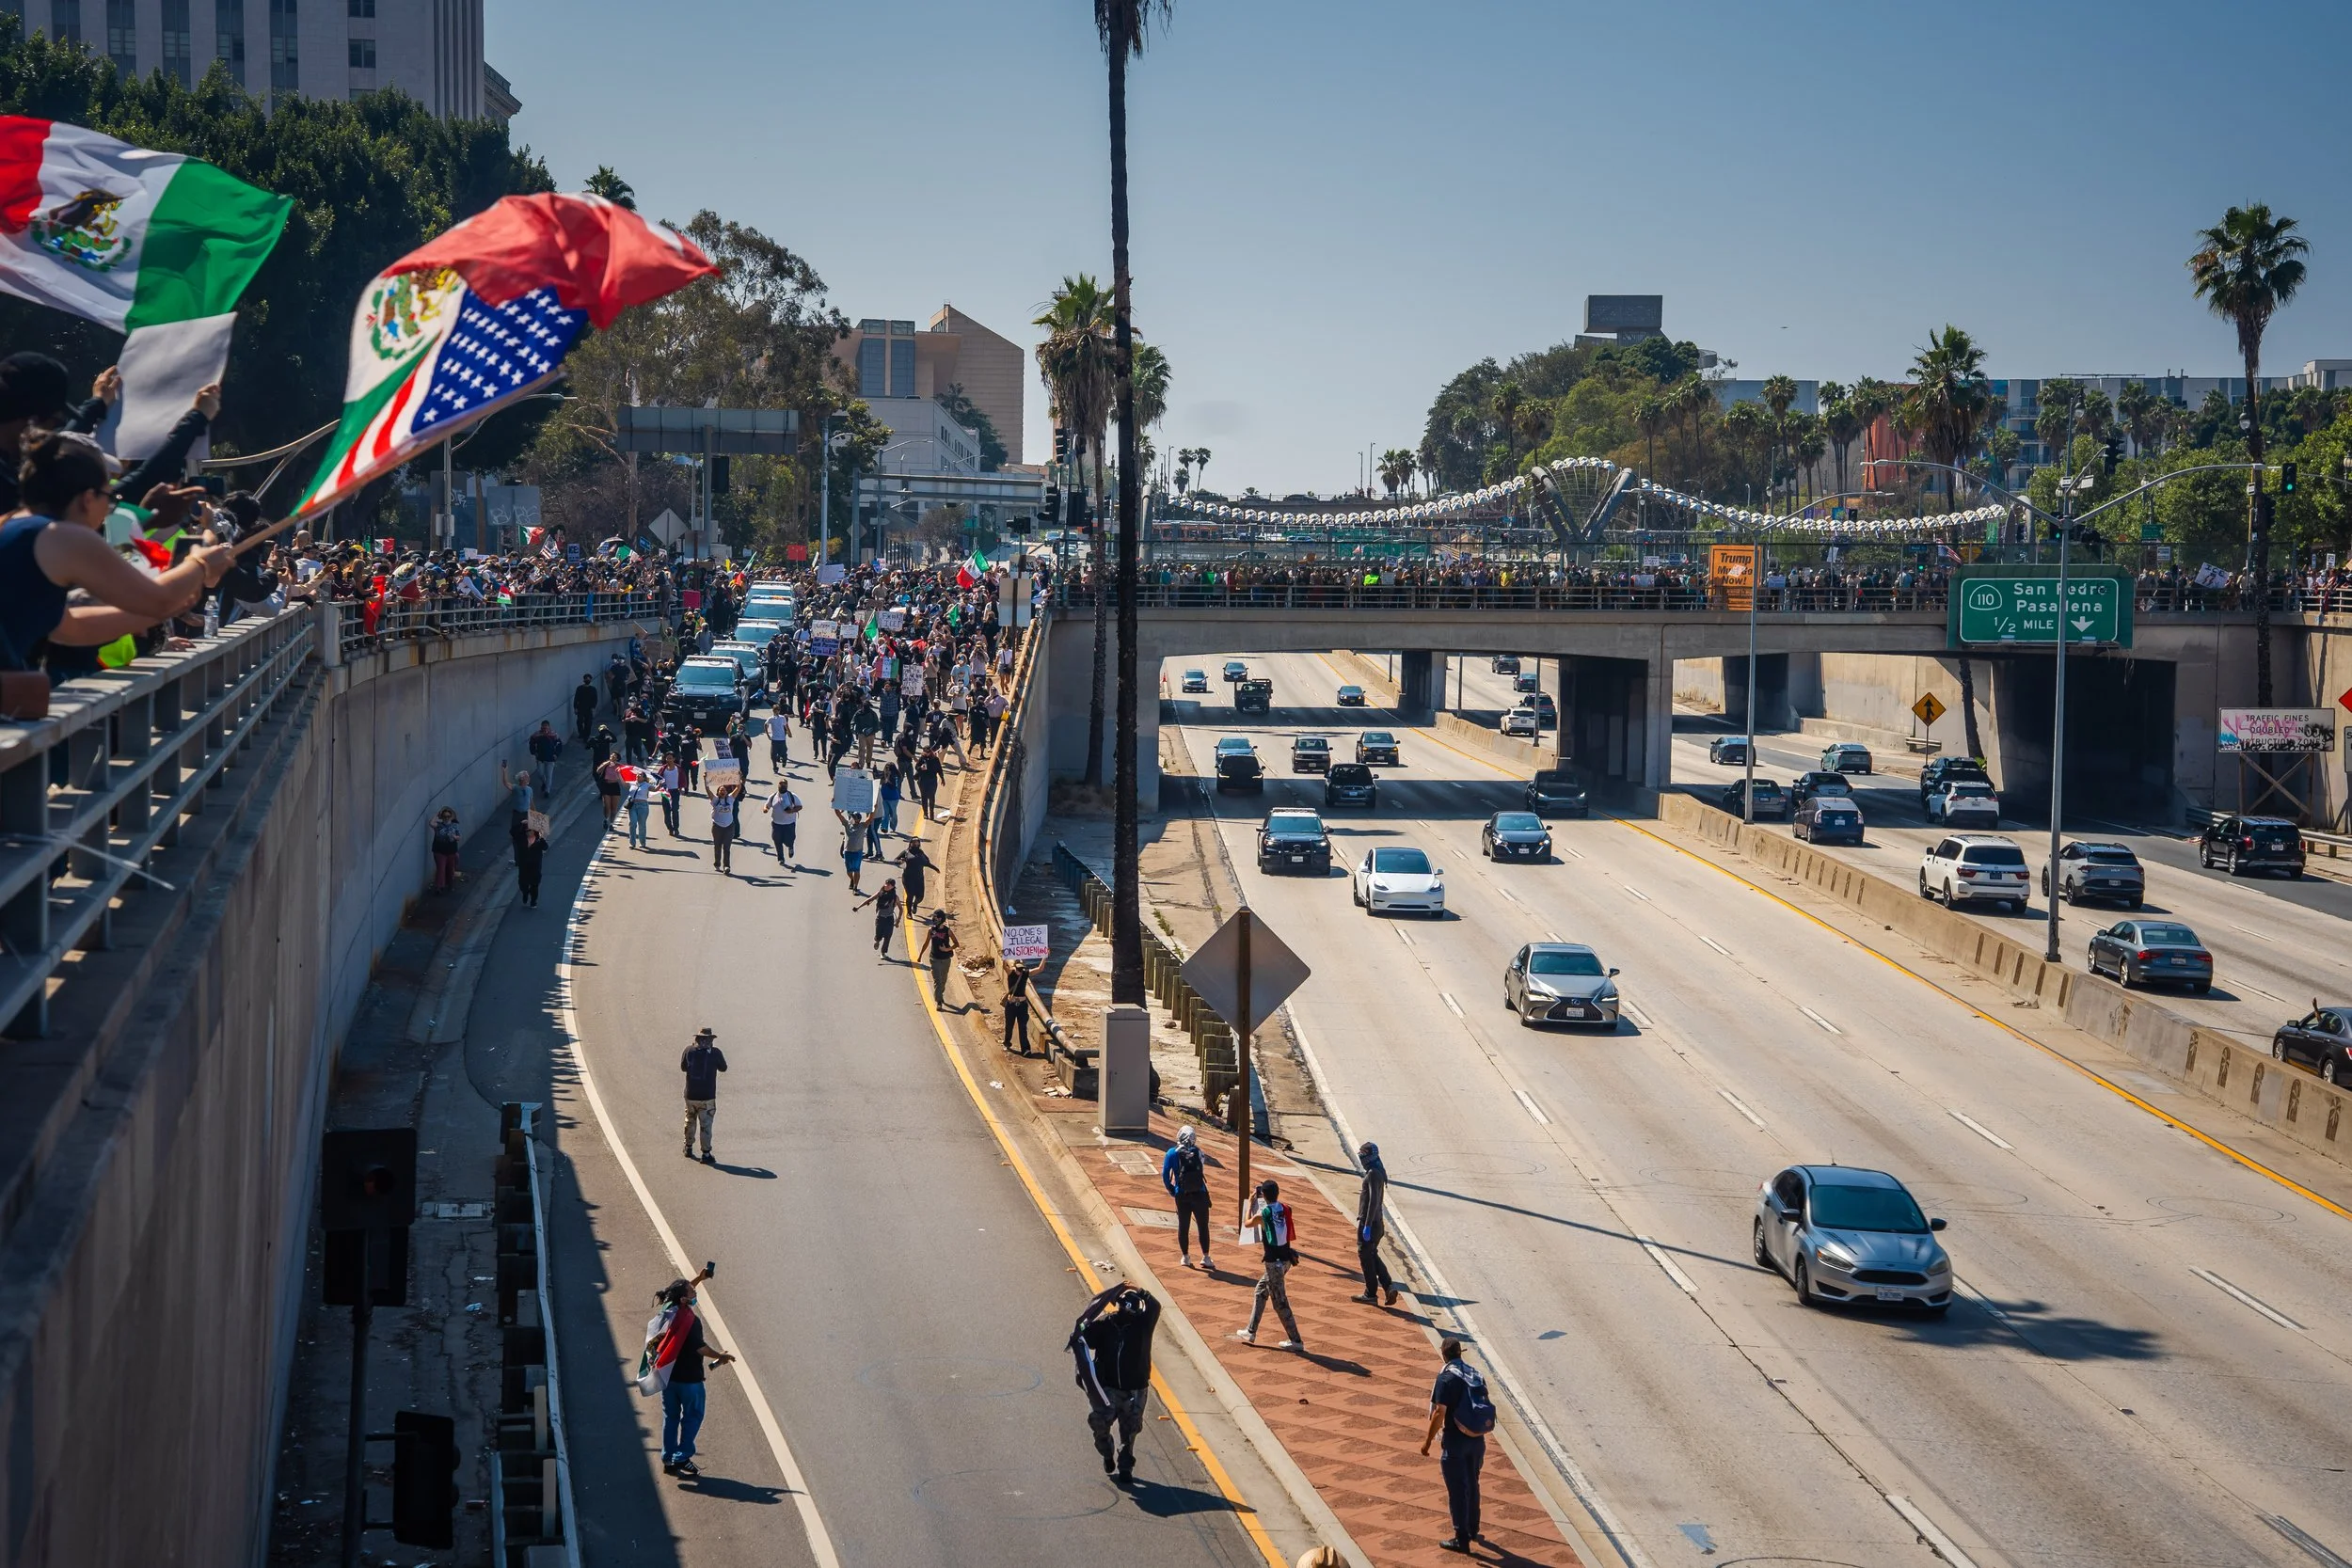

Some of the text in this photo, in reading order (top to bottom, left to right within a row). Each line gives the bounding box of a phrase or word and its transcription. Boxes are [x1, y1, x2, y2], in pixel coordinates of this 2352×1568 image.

[1720, 553, 1752, 565] Trump
[2205, 564, 2225, 578] ICE
[1722, 576, 1746, 585] Now!
[2013, 583, 2046, 594] San
[1978, 594, 1994, 606] 110
[2024, 620, 2055, 629] MILE
[1004, 928, 1016, 937] NO
[1009, 937, 1044, 946] ILLEGAL
[1003, 947, 1015, 957] ON
[1016, 946, 1037, 956] STOLEN
